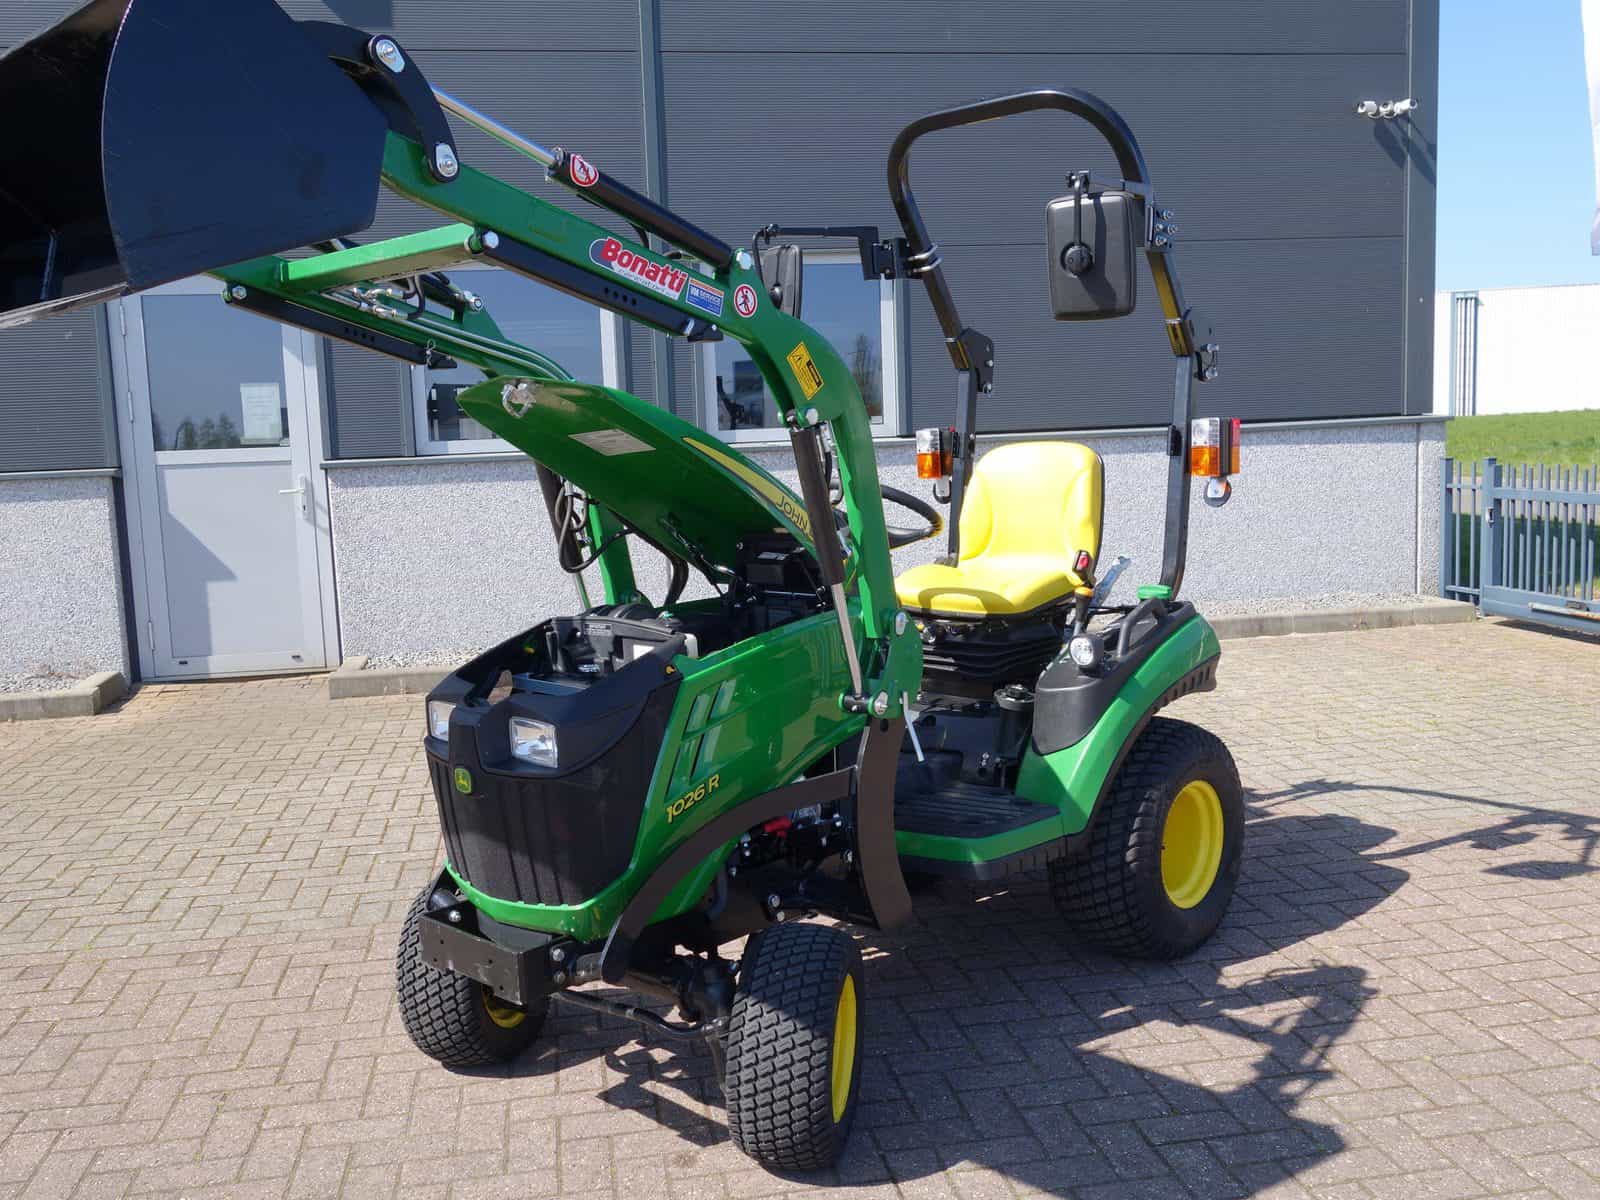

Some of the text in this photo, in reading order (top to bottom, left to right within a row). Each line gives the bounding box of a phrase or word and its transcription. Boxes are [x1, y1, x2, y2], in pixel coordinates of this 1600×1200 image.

[601, 237, 688, 293] Bonatti
[776, 495, 808, 531] JOHN
[666, 773, 720, 824] 1026 R
